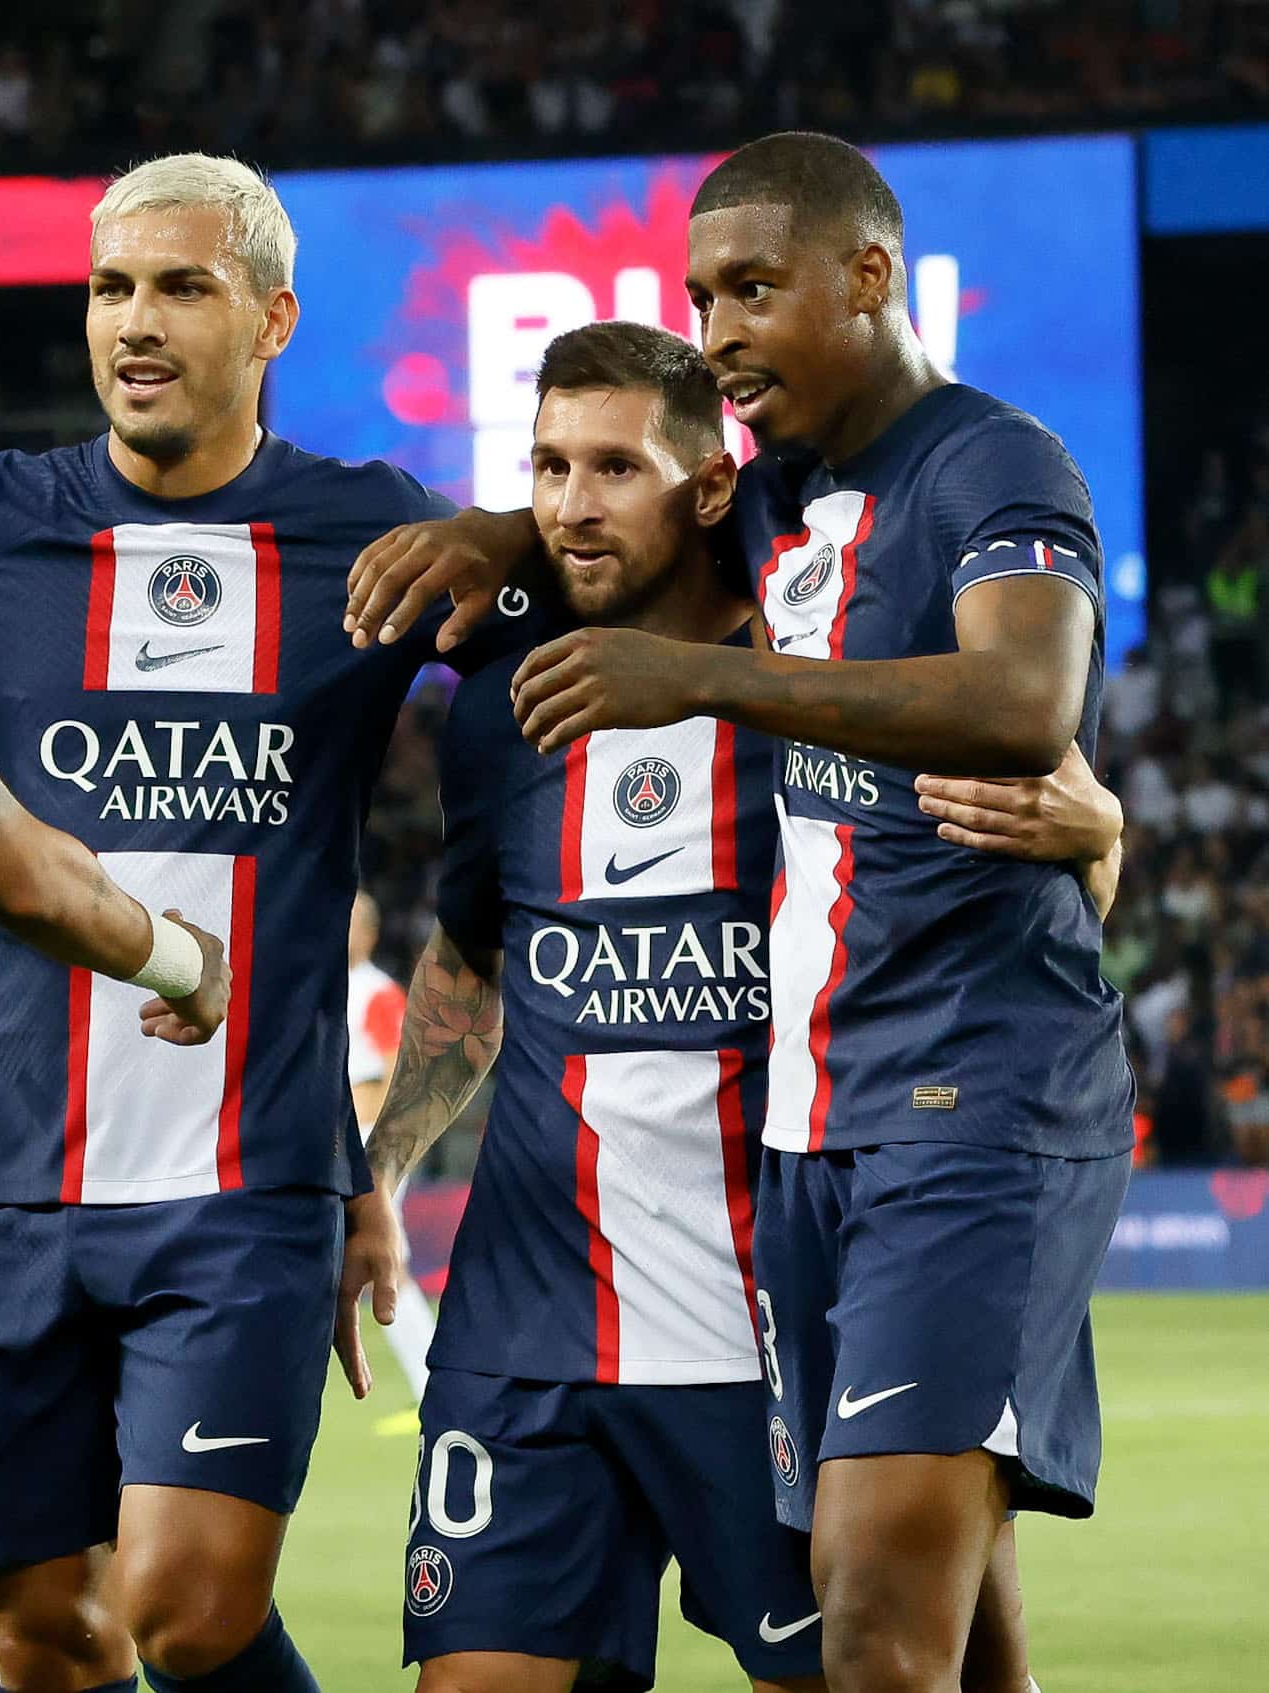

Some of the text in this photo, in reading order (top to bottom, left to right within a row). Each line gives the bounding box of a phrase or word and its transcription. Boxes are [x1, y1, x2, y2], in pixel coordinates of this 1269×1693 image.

[162, 560, 209, 578] PARIS
[39, 719, 295, 793] QATAR
[626, 761, 670, 780] PARIS
[784, 748, 880, 806] IRWAYS
[99, 785, 290, 826] AIRWAYS
[528, 921, 769, 998] QATAR
[576, 986, 770, 1024] AIRWAYS
